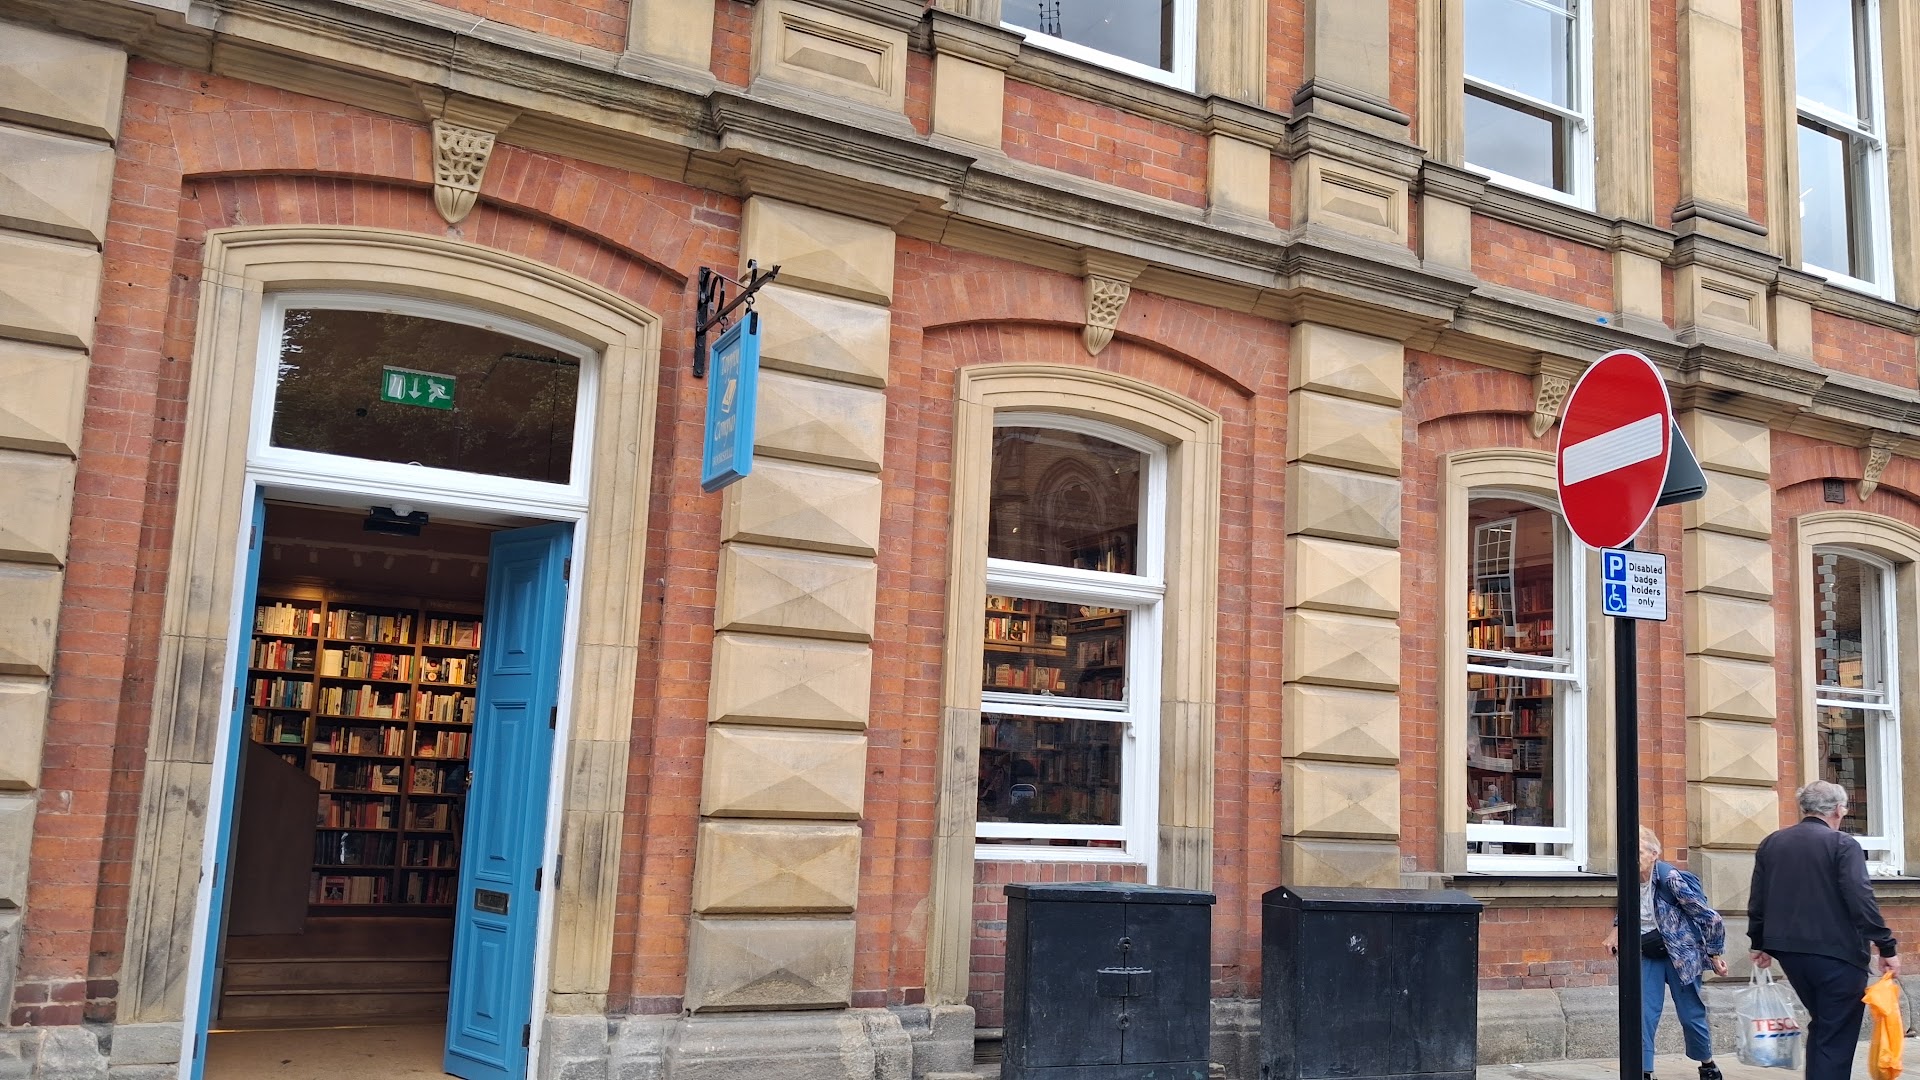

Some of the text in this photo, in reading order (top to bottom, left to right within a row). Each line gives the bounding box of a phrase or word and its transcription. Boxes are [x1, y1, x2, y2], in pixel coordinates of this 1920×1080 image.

[1609, 555, 1623, 578] P
[1629, 562, 1663, 575] Disabled
[1634, 574, 1658, 585] badge
[1631, 584, 1661, 596] holders
[1638, 597, 1655, 608] only
